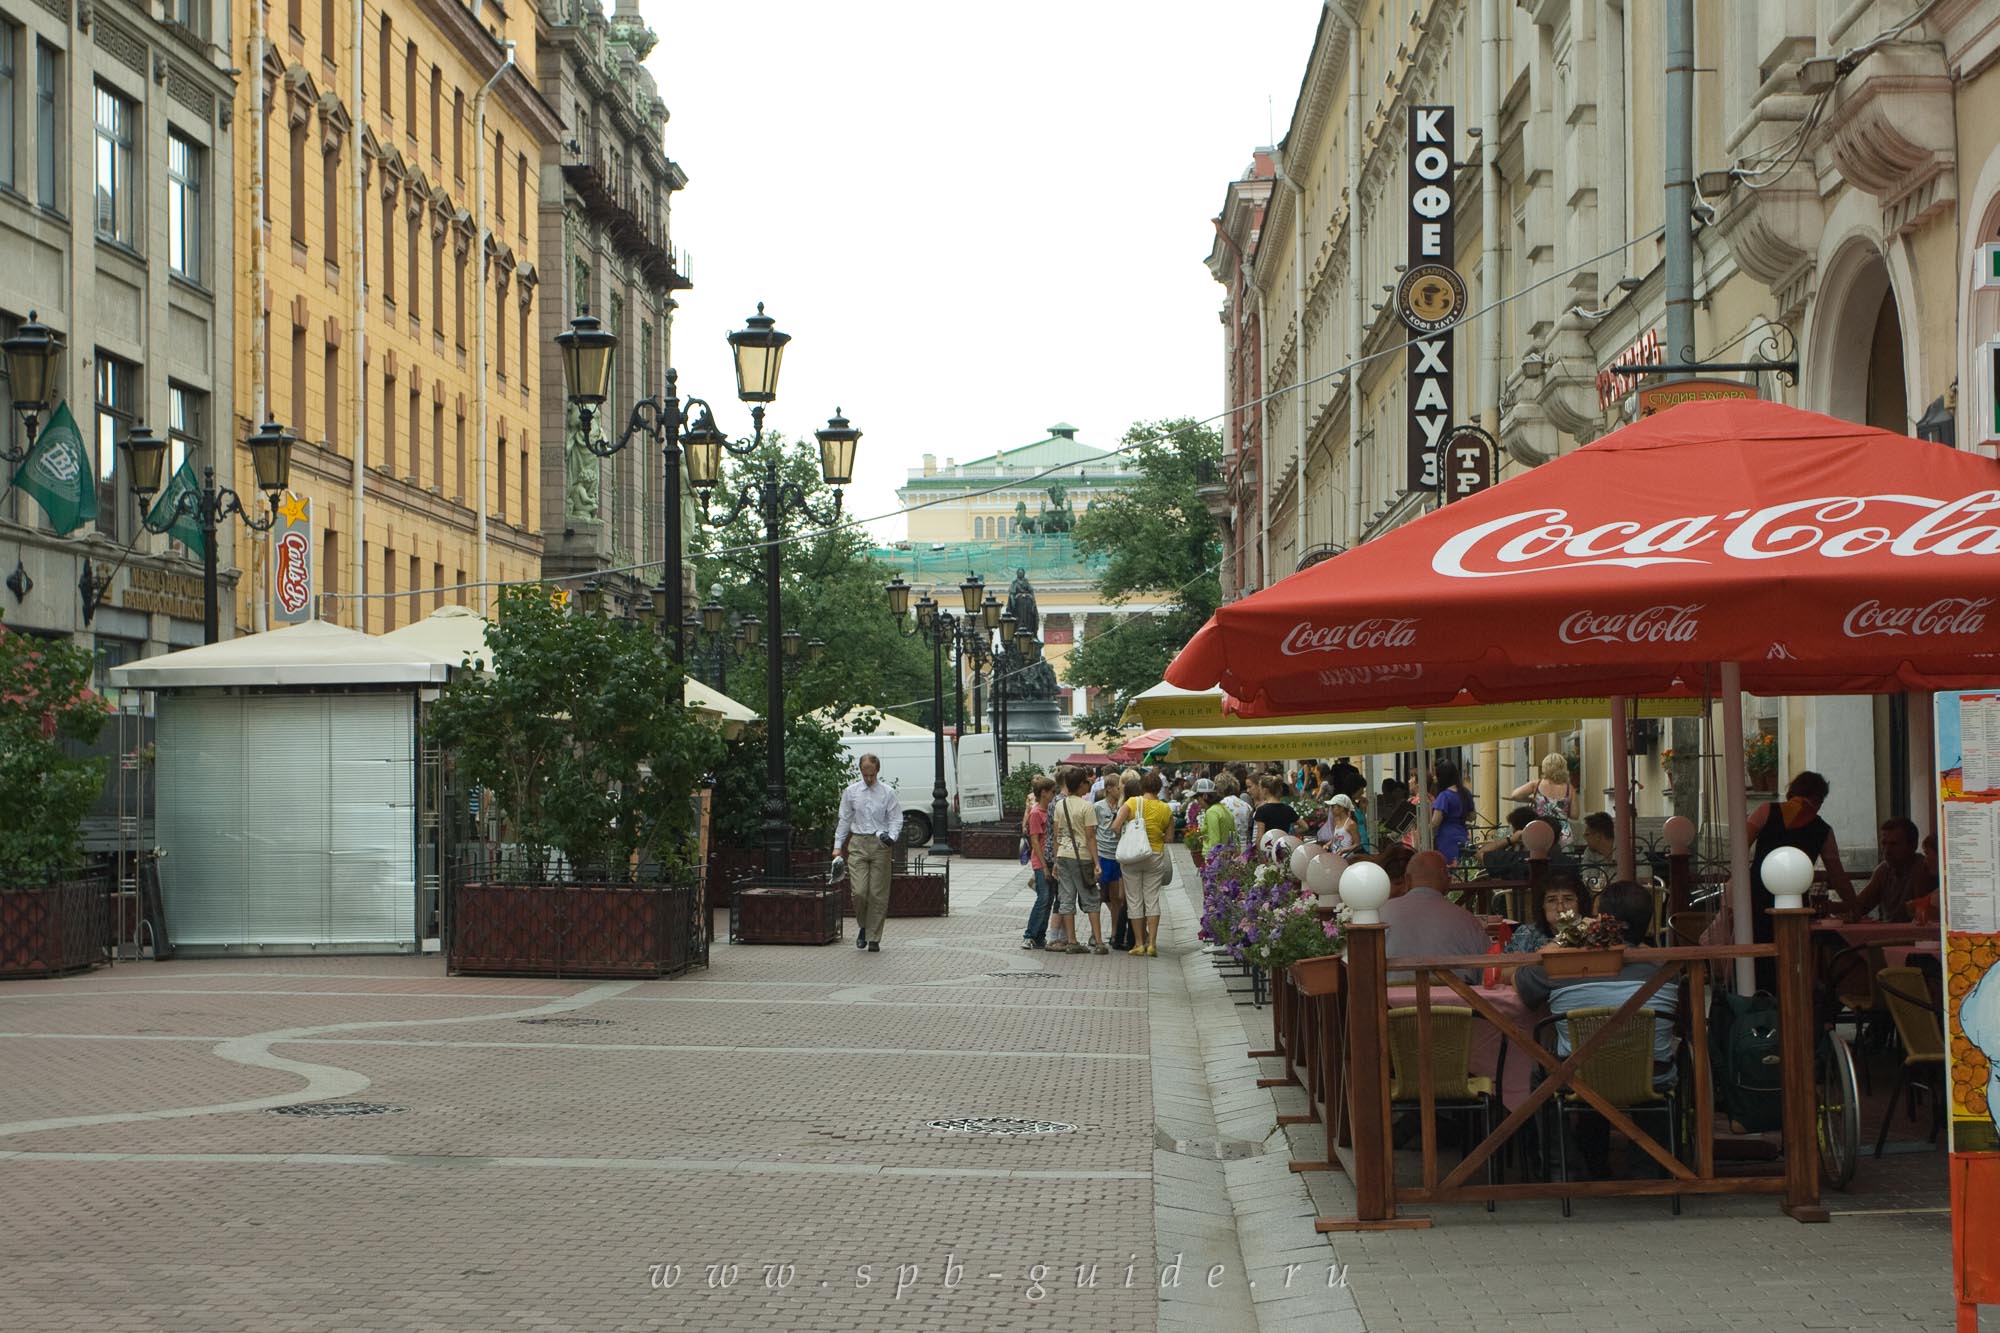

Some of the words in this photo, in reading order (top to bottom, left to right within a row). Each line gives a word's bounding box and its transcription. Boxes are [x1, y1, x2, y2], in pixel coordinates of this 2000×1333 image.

[1413, 110, 1450, 256] КОФЕ
[1409, 315, 1431, 330] КОФЕ
[1434, 315, 1454, 330] ХАУЗ
[1414, 340, 1449, 486] ХАУЗ
[1649, 391, 1696, 405] СТУДИЯ
[1700, 390, 1747, 401] ЗАГАРА
[1456, 448, 1481, 499] ТР
[1432, 490, 2000, 578] Coca-Cola
[286, 534, 307, 584] Carl's
[1281, 617, 1422, 656] Coca-Cola
[1558, 603, 1706, 644] Coca-Cola
[1843, 597, 1996, 638] Coca-Cola
